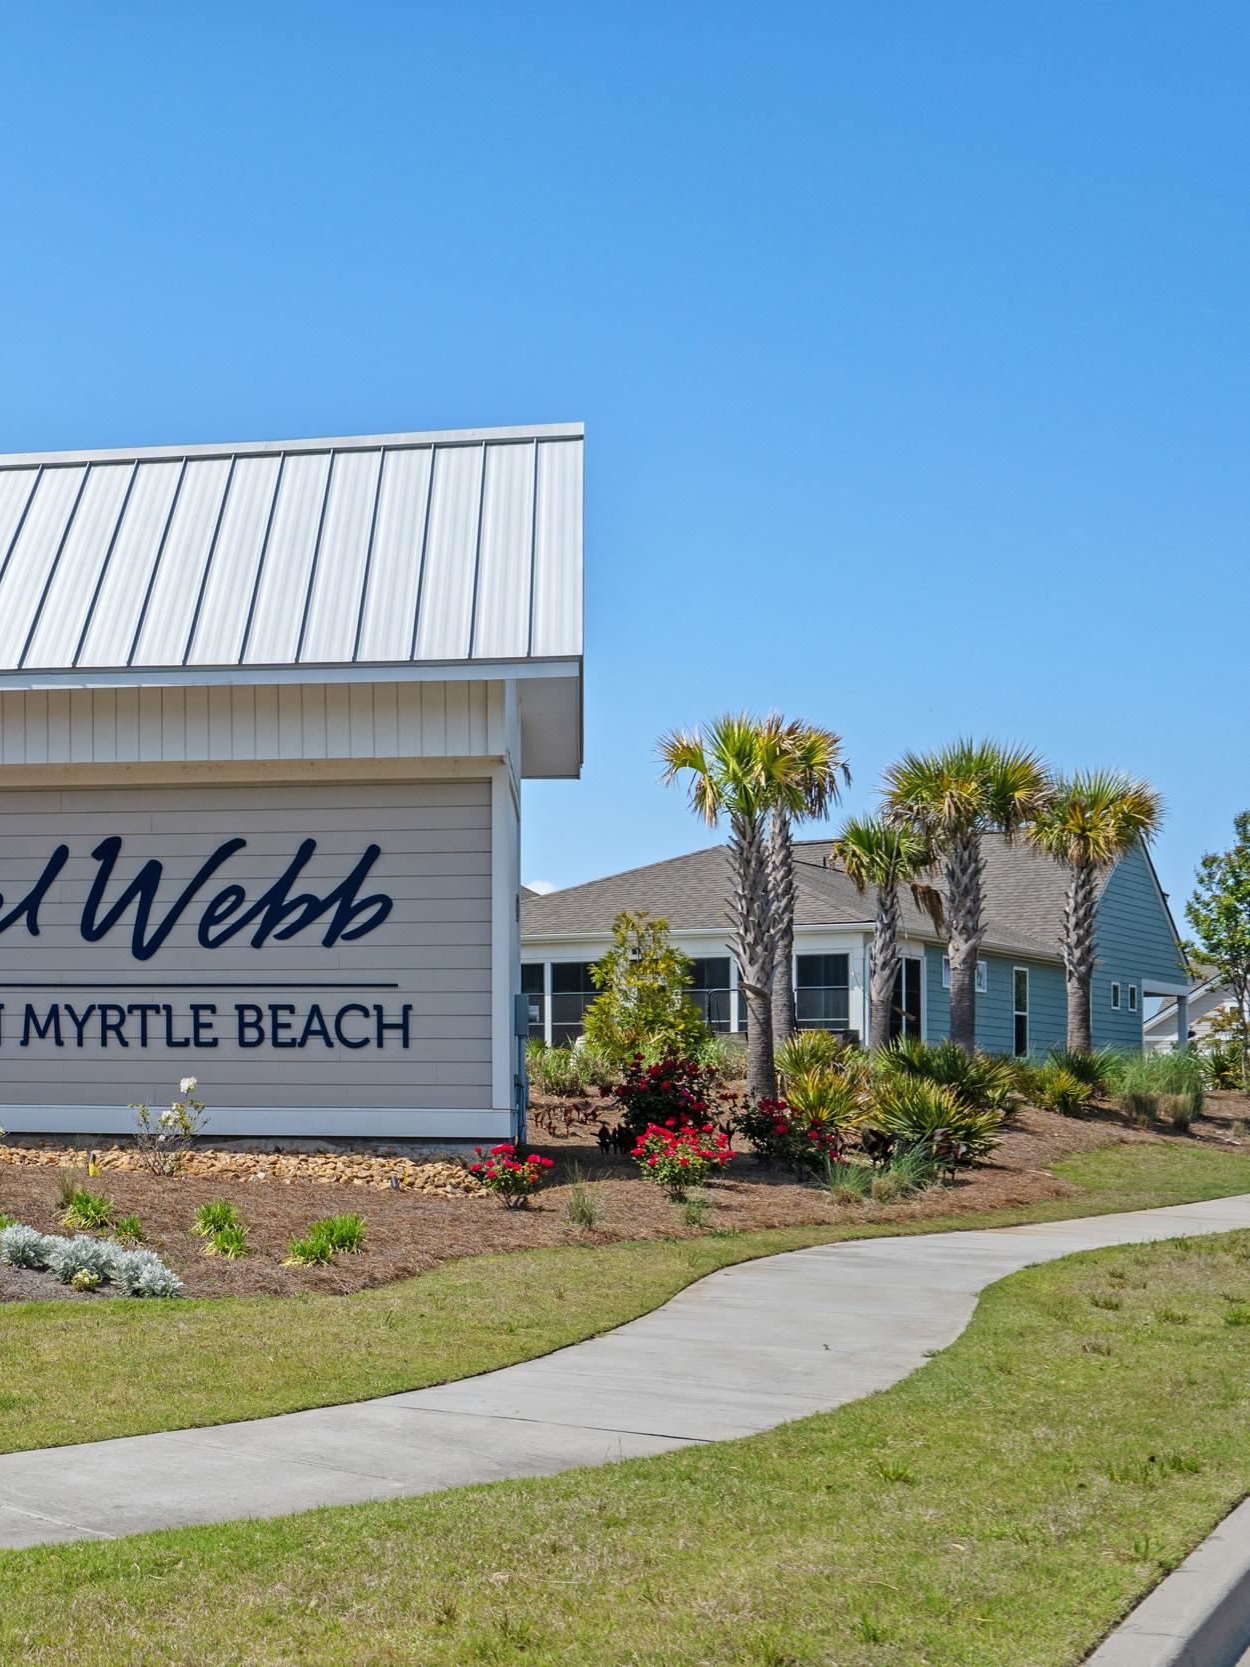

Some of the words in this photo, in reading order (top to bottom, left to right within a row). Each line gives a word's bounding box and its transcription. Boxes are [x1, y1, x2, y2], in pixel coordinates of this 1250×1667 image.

[80, 835, 394, 961] Webb
[19, 1003, 219, 1048] MYRTLE
[234, 1003, 413, 1049] BEACH
